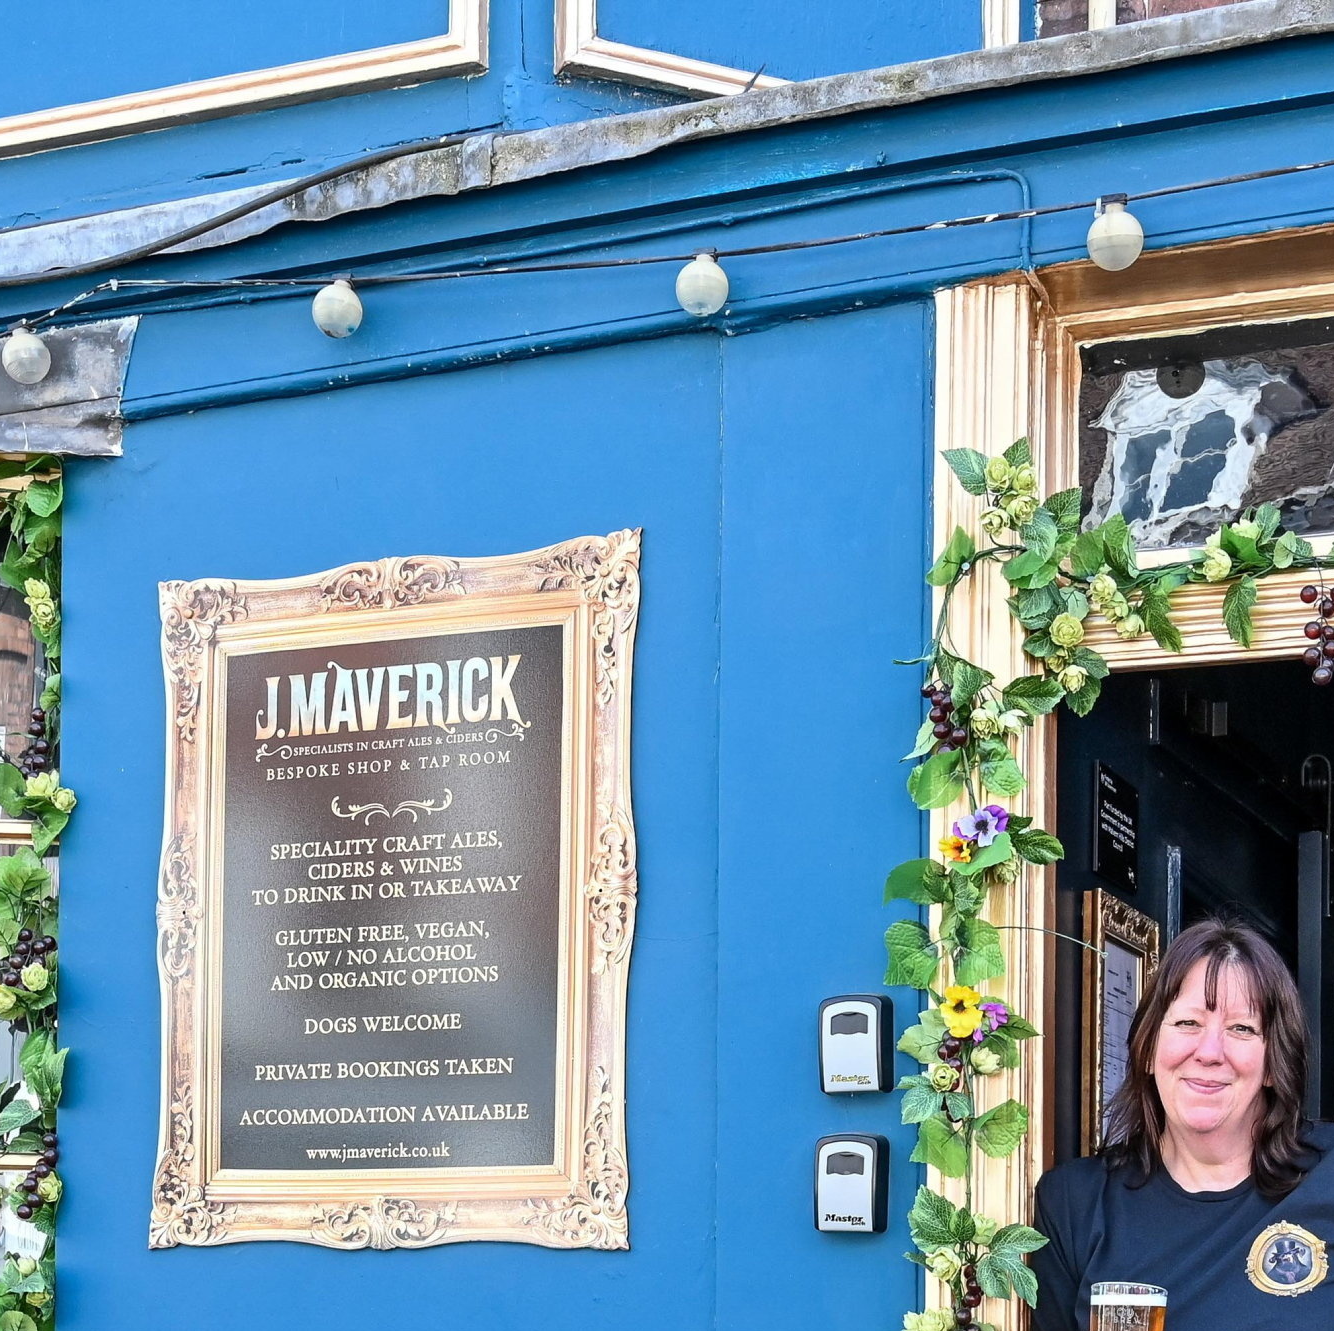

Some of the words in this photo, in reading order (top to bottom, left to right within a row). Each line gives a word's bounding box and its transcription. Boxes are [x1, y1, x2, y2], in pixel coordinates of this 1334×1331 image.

[255, 654, 532, 740] J.MAVERICK
[294, 743, 353, 756] SPECIALISTS
[357, 742, 368, 751] IN
[372, 739, 405, 749] CRAFT
[408, 737, 432, 746] ALES
[446, 732, 483, 743] CIDERS
[267, 764, 340, 781] BESPOKE
[348, 760, 391, 774] SHOP
[400, 760, 410, 770] &
[419, 755, 450, 769] TAP
[459, 751, 510, 766] ROOM
[271, 839, 377, 860] SPECIALITY
[383, 833, 446, 853] CRAFT
[450, 830, 502, 849] ALES,
[308, 861, 374, 880] CIDERS
[380, 862, 394, 875] &
[399, 855, 462, 874] WINES
[252, 889, 278, 905] TO
[284, 886, 346, 904] DRINK
[351, 884, 373, 900] IN
[379, 882, 406, 898] OR
[411, 875, 522, 896] TAKEAWAY
[275, 927, 352, 946] GLUTEN
[358, 925, 409, 943] FREE,
[414, 921, 489, 939] VEGAN,
[287, 951, 330, 968] LOW
[335, 950, 342, 966] /
[347, 949, 377, 965] NO
[383, 944, 477, 963] ALCOHOL
[271, 974, 313, 991] AND
[319, 969, 406, 989] ORGANIC
[412, 966, 498, 985] OPTIONS
[305, 1017, 356, 1034] DOGS
[362, 1013, 461, 1032] WELCOME
[255, 1063, 332, 1080] PRIVATE
[337, 1060, 439, 1078] BOOKINGS
[445, 1058, 513, 1075] TAKEN
[240, 1106, 416, 1125] ACCOMMODATION
[421, 1104, 529, 1121] AVAILABLE
[306, 1141, 450, 1163] www.jmaverick.co.uk
[825, 1214, 864, 1222] Master
